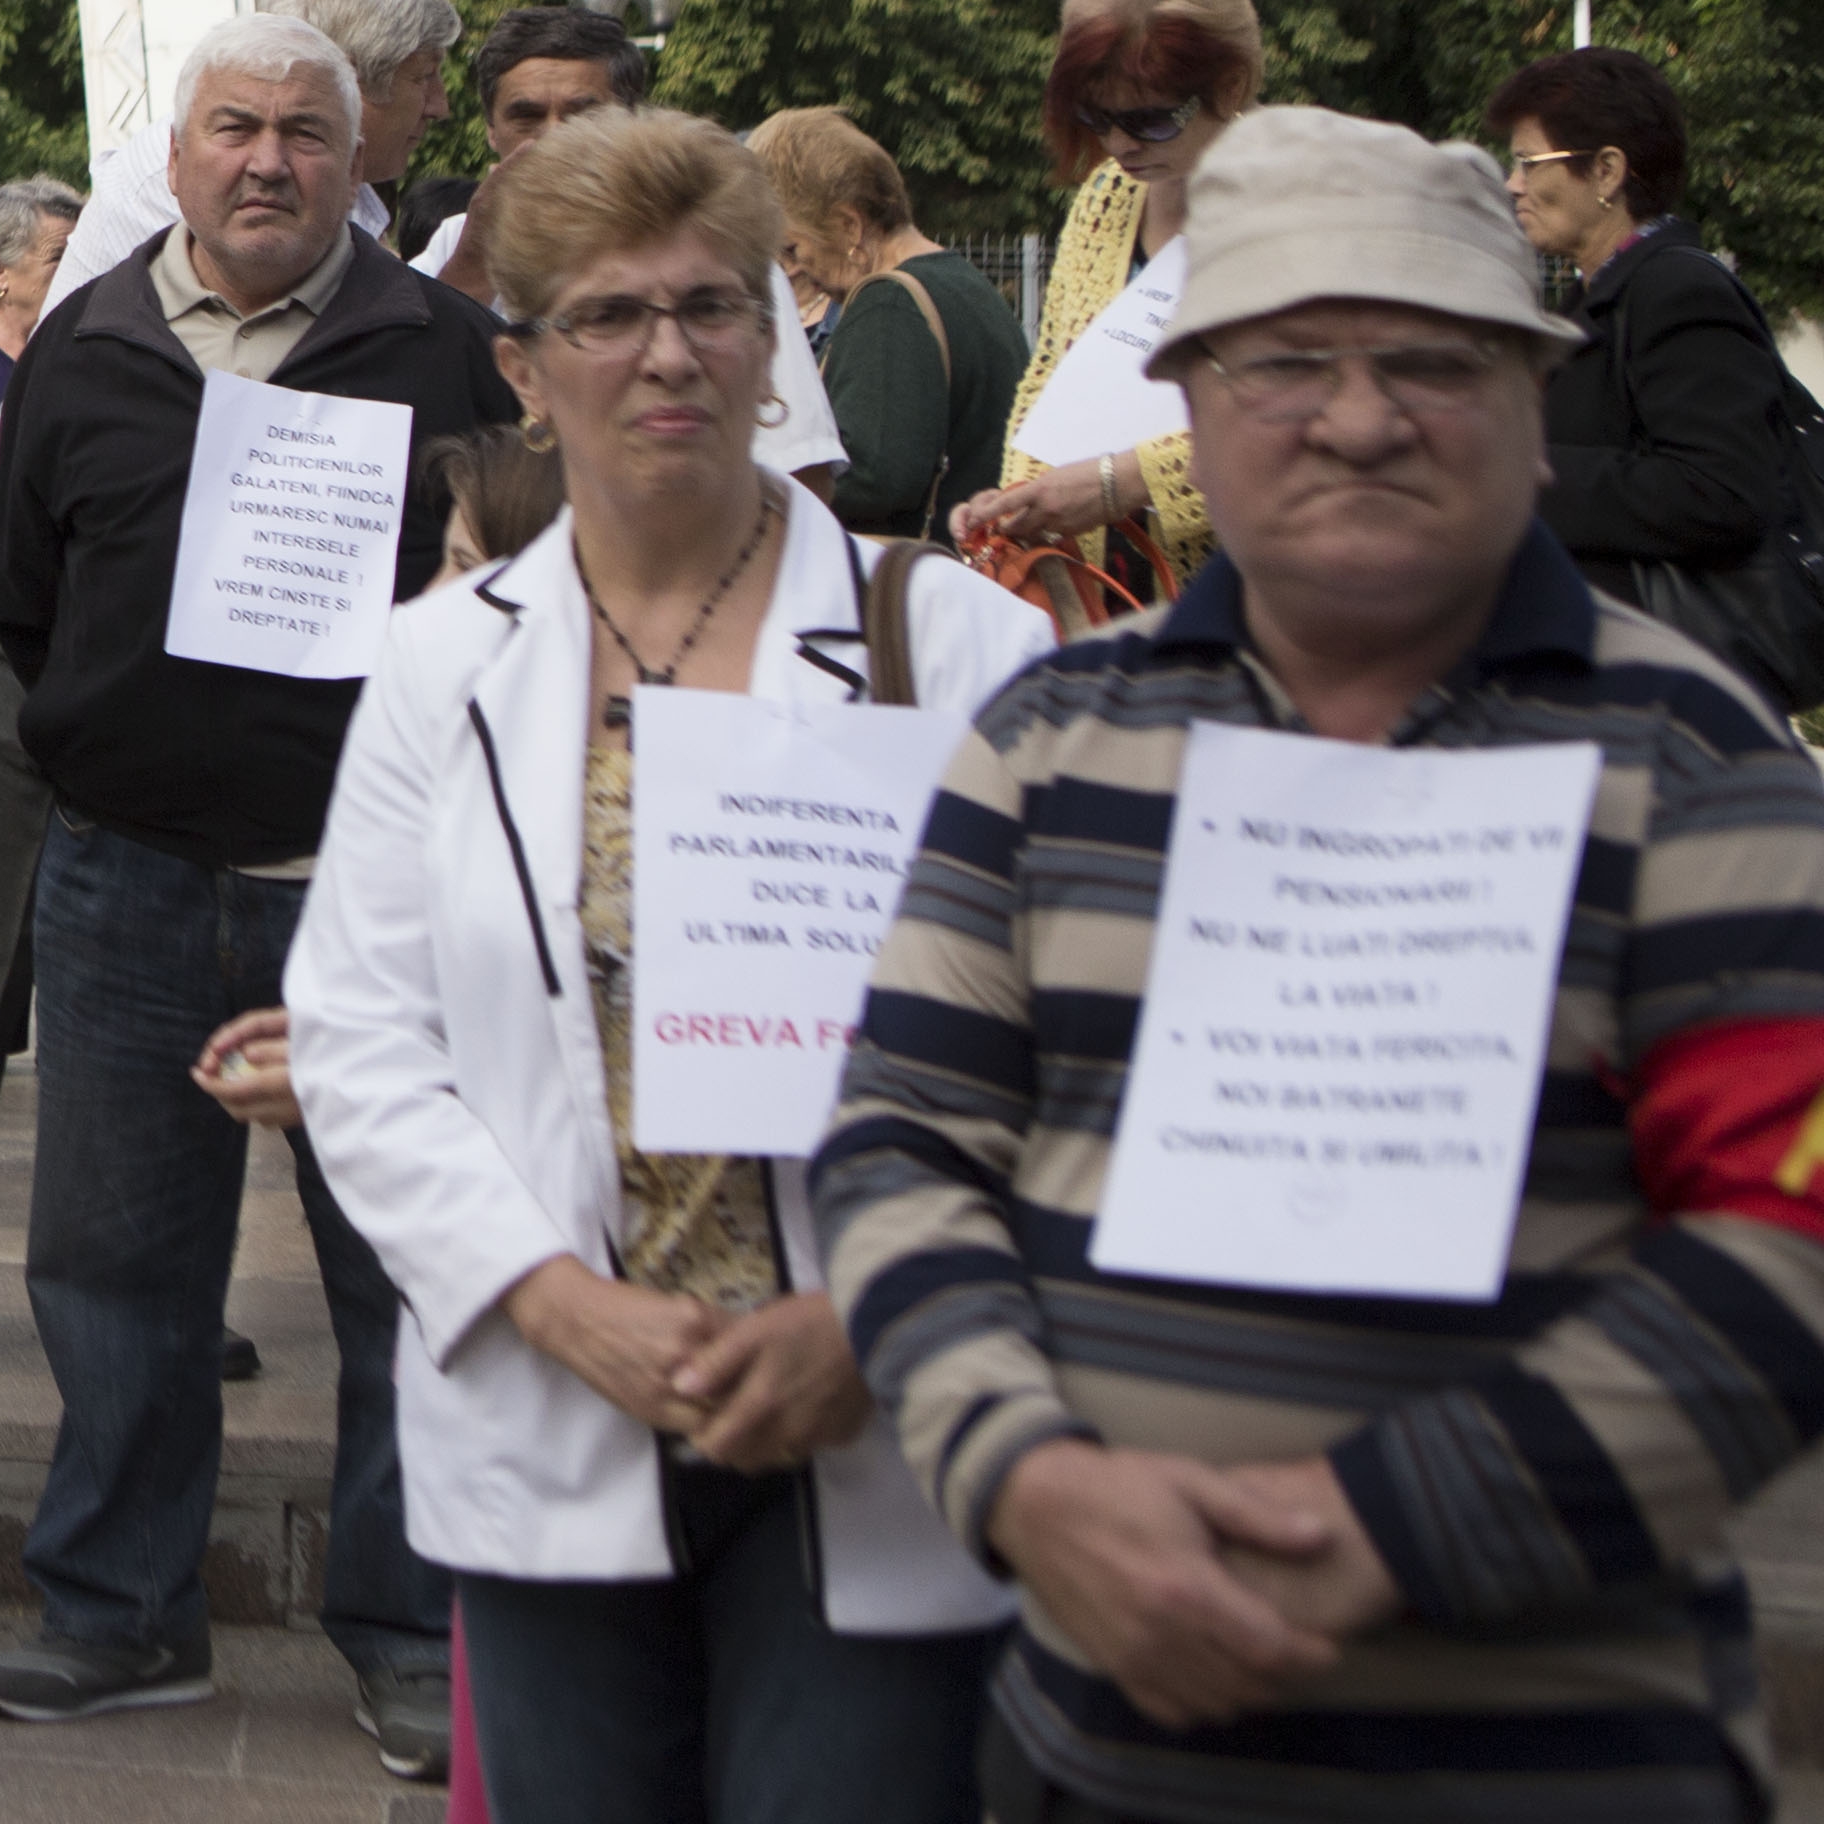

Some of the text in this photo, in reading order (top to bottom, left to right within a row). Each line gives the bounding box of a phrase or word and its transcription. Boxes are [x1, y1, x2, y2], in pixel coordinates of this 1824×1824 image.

[266, 424, 337, 446] DEMISIA
[248, 448, 384, 478] POLITICIENILOR
[327, 485, 395, 507] FIINDCA
[230, 500, 389, 535] URMARESC NUMAI
[254, 529, 361, 558] INTERESELE
[243, 554, 349, 584] PERSONALE
[214, 577, 352, 613] VREM CINSTE SI
[719, 793, 901, 833] INDIFERENTA
[752, 878, 880, 914] DUCE LA
[683, 918, 791, 948] ULTIMA
[656, 1013, 804, 1049] GREVA
